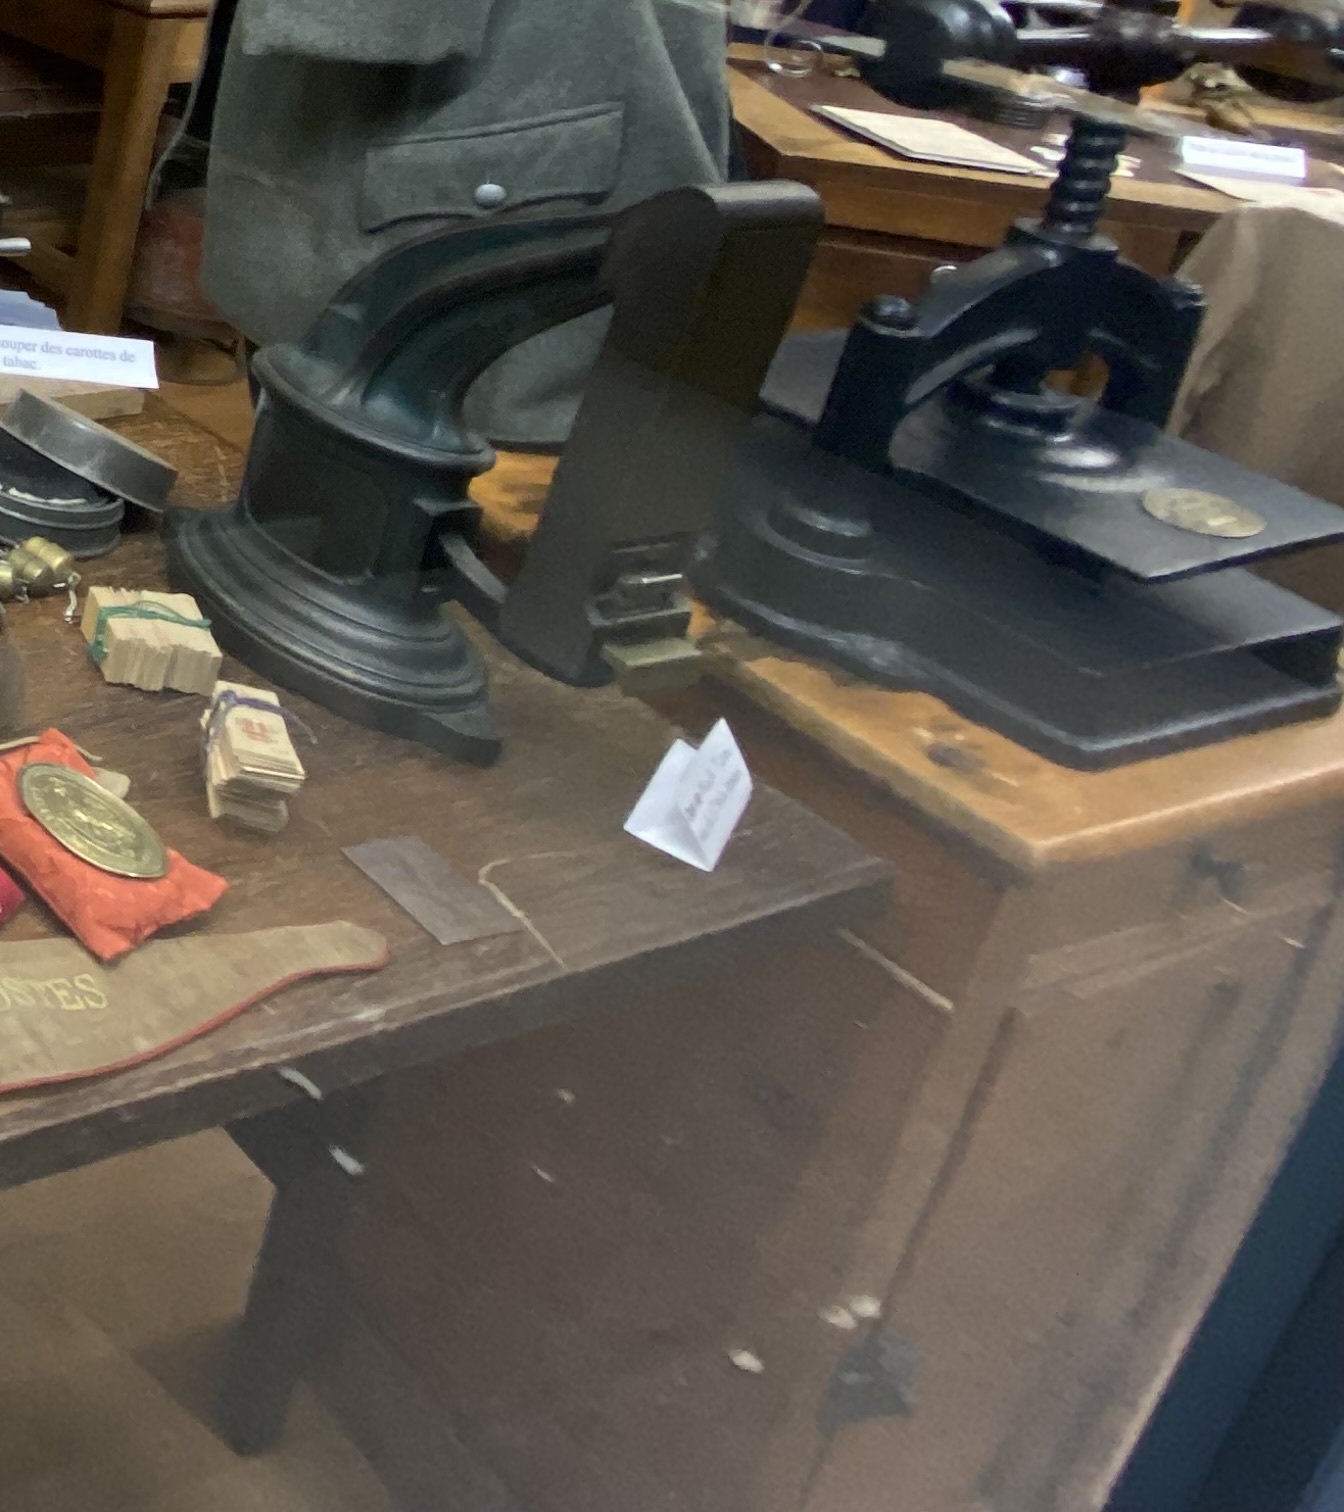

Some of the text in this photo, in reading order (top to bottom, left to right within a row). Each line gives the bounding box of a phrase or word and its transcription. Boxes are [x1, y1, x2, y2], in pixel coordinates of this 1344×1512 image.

[40, 340, 62, 355] des
[66, 345, 116, 361] carottes
[119, 350, 135, 363] de
[3, 356, 40, 370] tabac.
